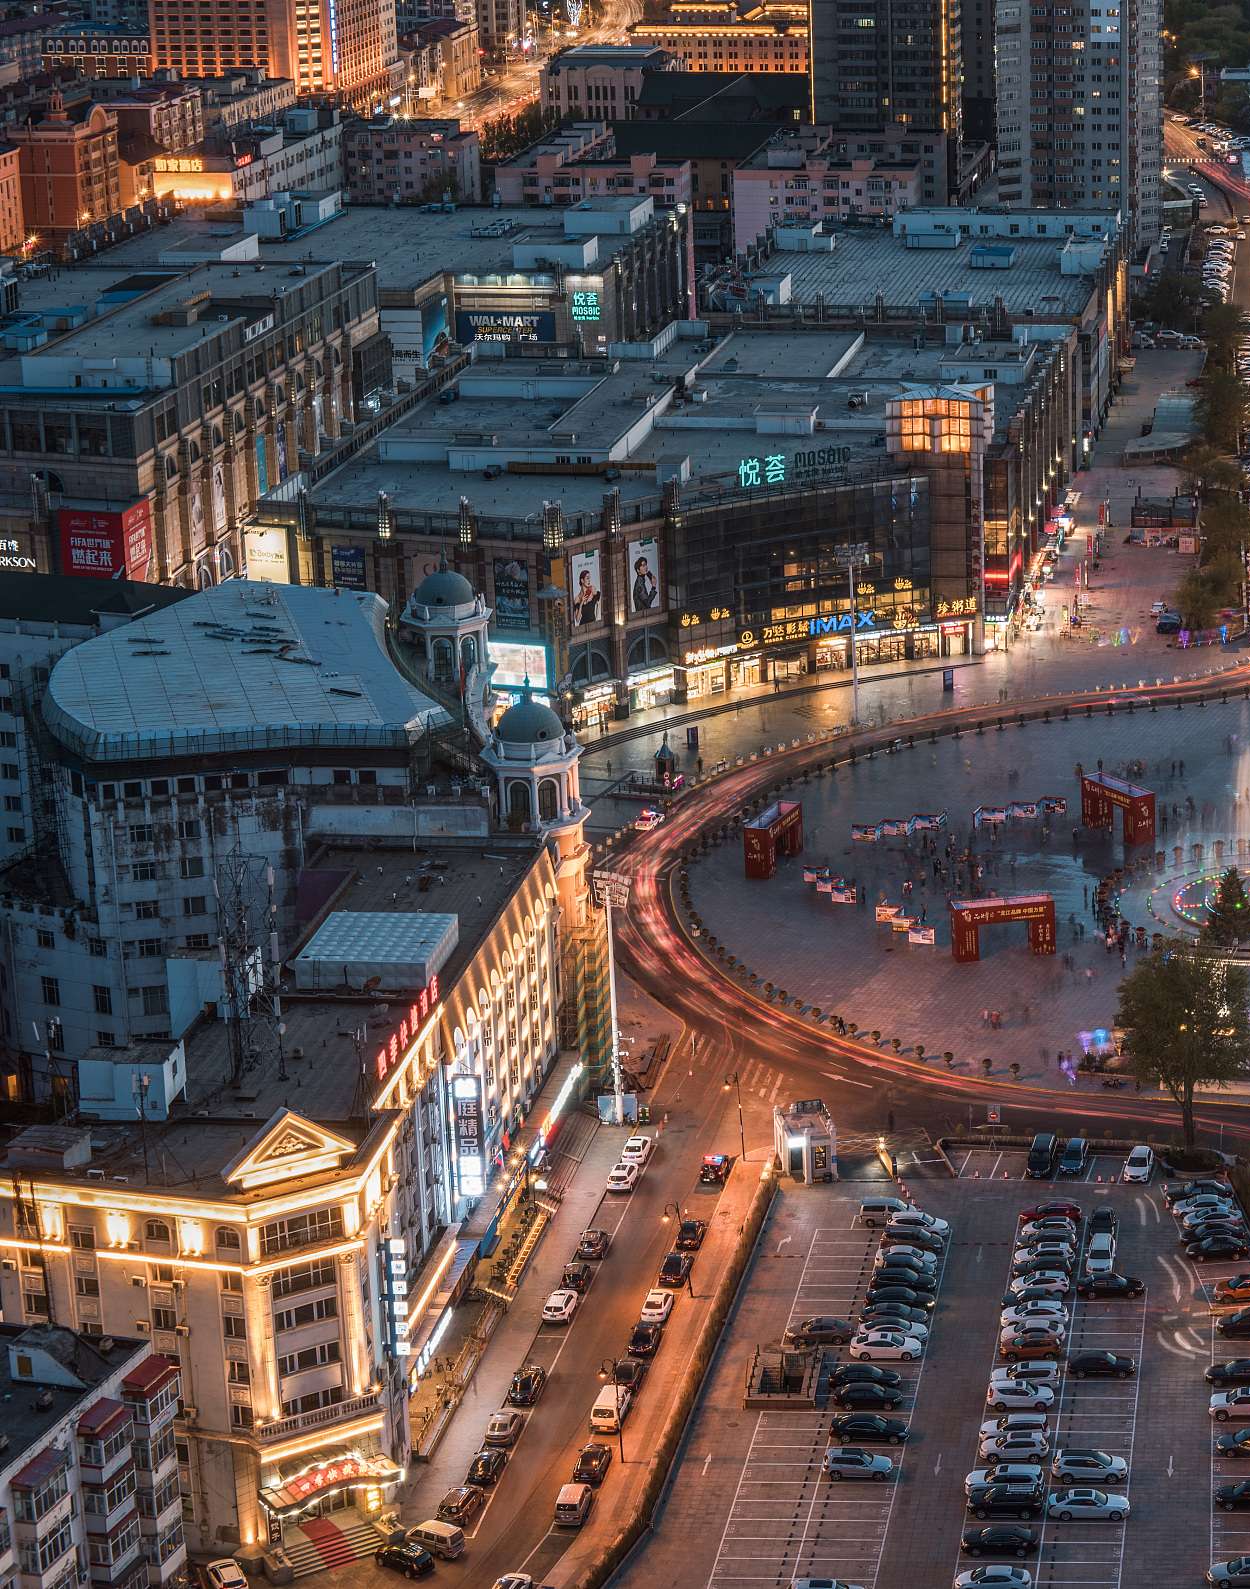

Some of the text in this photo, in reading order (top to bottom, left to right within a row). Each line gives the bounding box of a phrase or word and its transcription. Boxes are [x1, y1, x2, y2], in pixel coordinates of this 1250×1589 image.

[574, 291, 598, 306] 悦荟
[474, 333, 538, 341] 沃尔玛购广场
[477, 326, 533, 334] SUPERCETER
[739, 454, 785, 487] 悦荟
[937, 596, 977, 614] 珍粥道
[809, 610, 876, 636] IMAX
